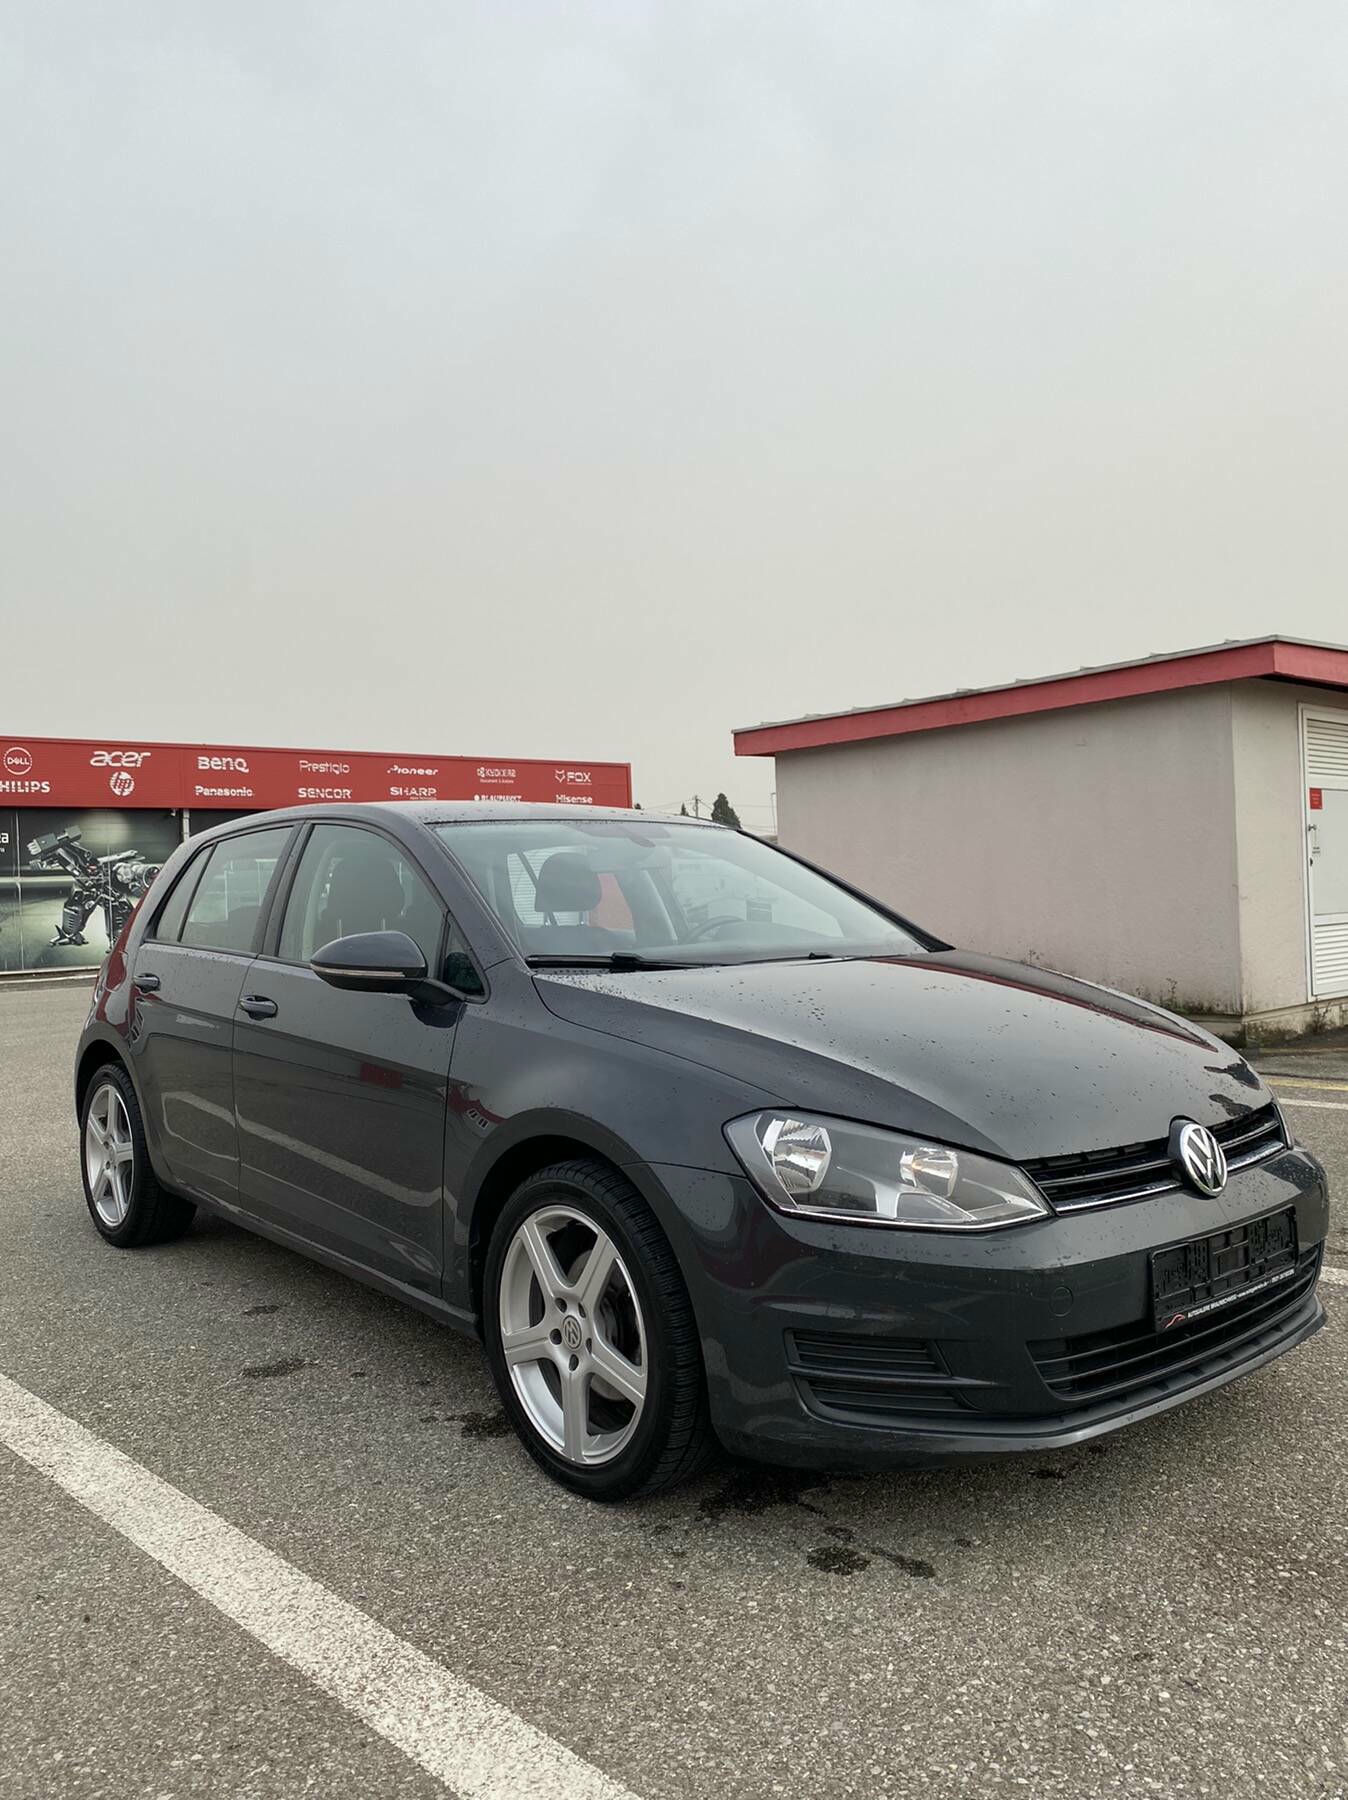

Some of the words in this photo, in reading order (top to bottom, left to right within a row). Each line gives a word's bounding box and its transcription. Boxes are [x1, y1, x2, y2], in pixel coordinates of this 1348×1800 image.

[7, 757, 30, 766] DELL
[90, 751, 151, 768] acer
[197, 756, 250, 773] BenQ
[299, 760, 350, 775] Prestigio
[387, 764, 439, 776] Pioneer
[567, 771, 592, 783] FOX
[0, 780, 51, 793] HILIPS
[195, 785, 254, 797] Panasonic
[390, 786, 437, 797] SHARP
[298, 787, 352, 799] SENCOR
[555, 794, 593, 804] Hisense
